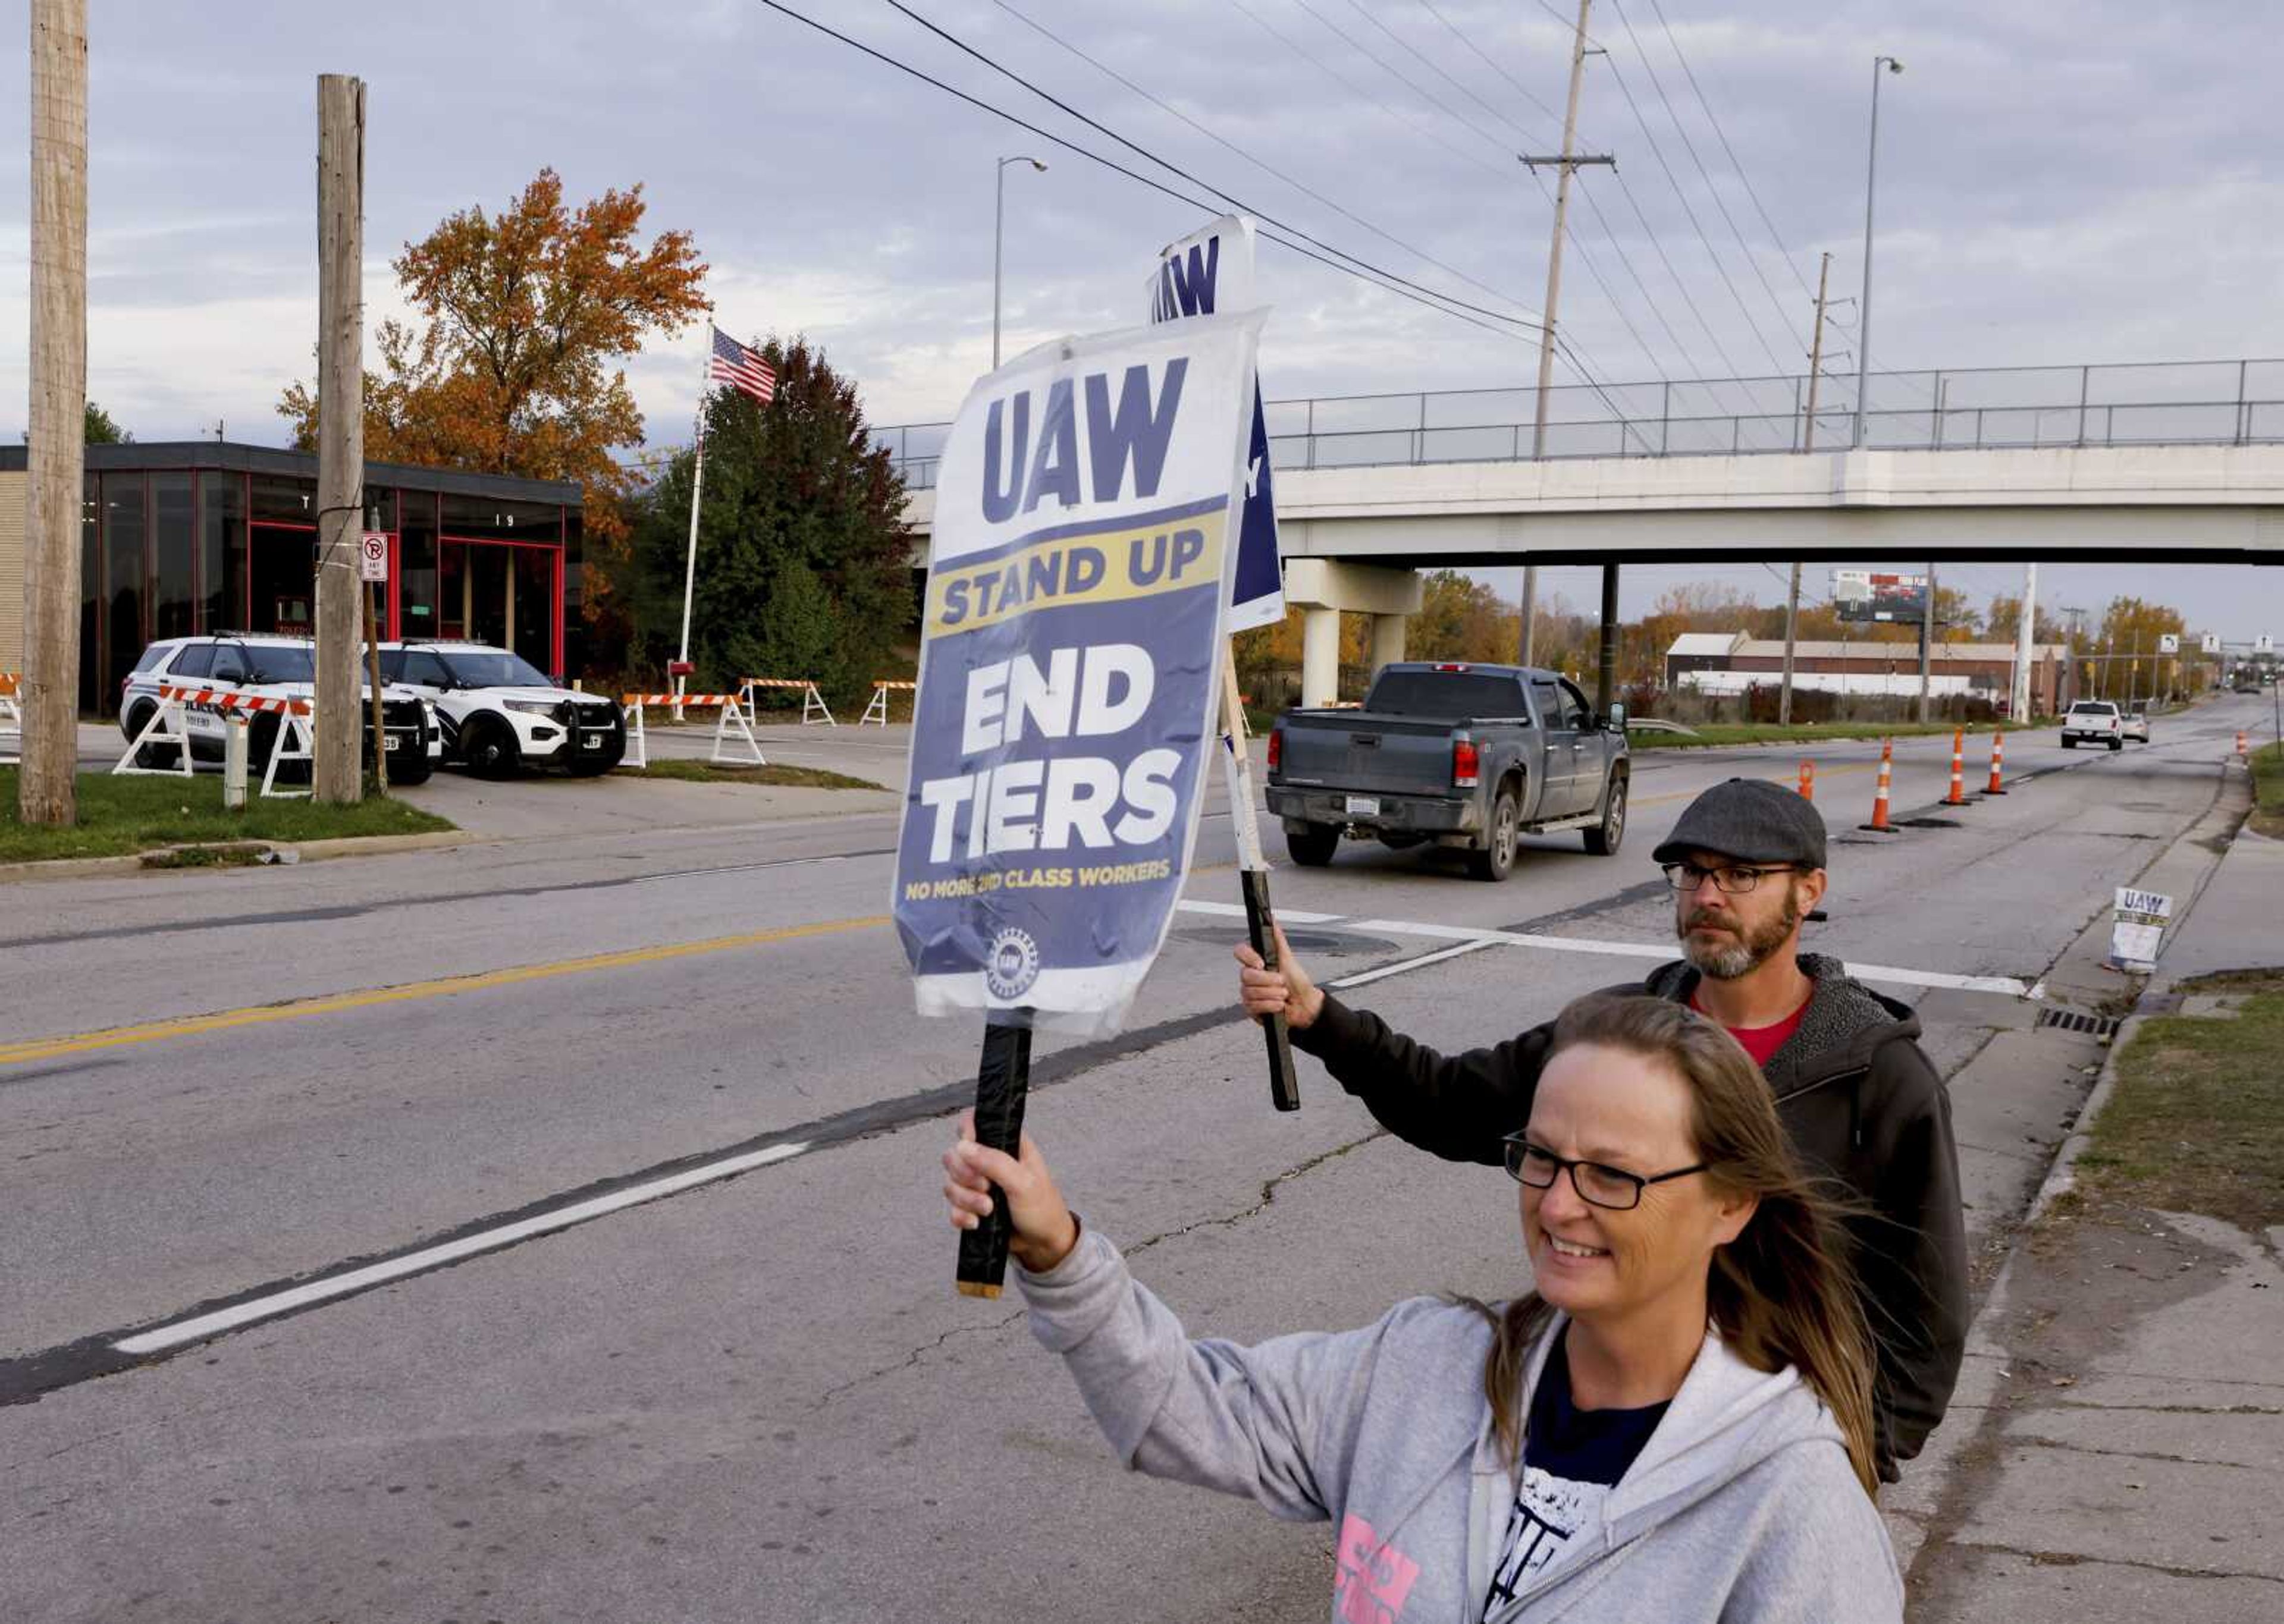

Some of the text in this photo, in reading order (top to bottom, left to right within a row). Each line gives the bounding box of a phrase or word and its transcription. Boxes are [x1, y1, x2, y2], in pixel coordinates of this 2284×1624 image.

[981, 357, 1189, 524] UAW
[941, 528, 1204, 624] STAND UP
[961, 643, 1155, 755] END
[921, 747, 1183, 863] TIERS
[905, 881, 930, 901] NO
[933, 876, 975, 899] MORE
[1005, 867, 1073, 888] CLASS
[1078, 858, 1171, 887] WORKERS
[2125, 891, 2163, 913] UAW
